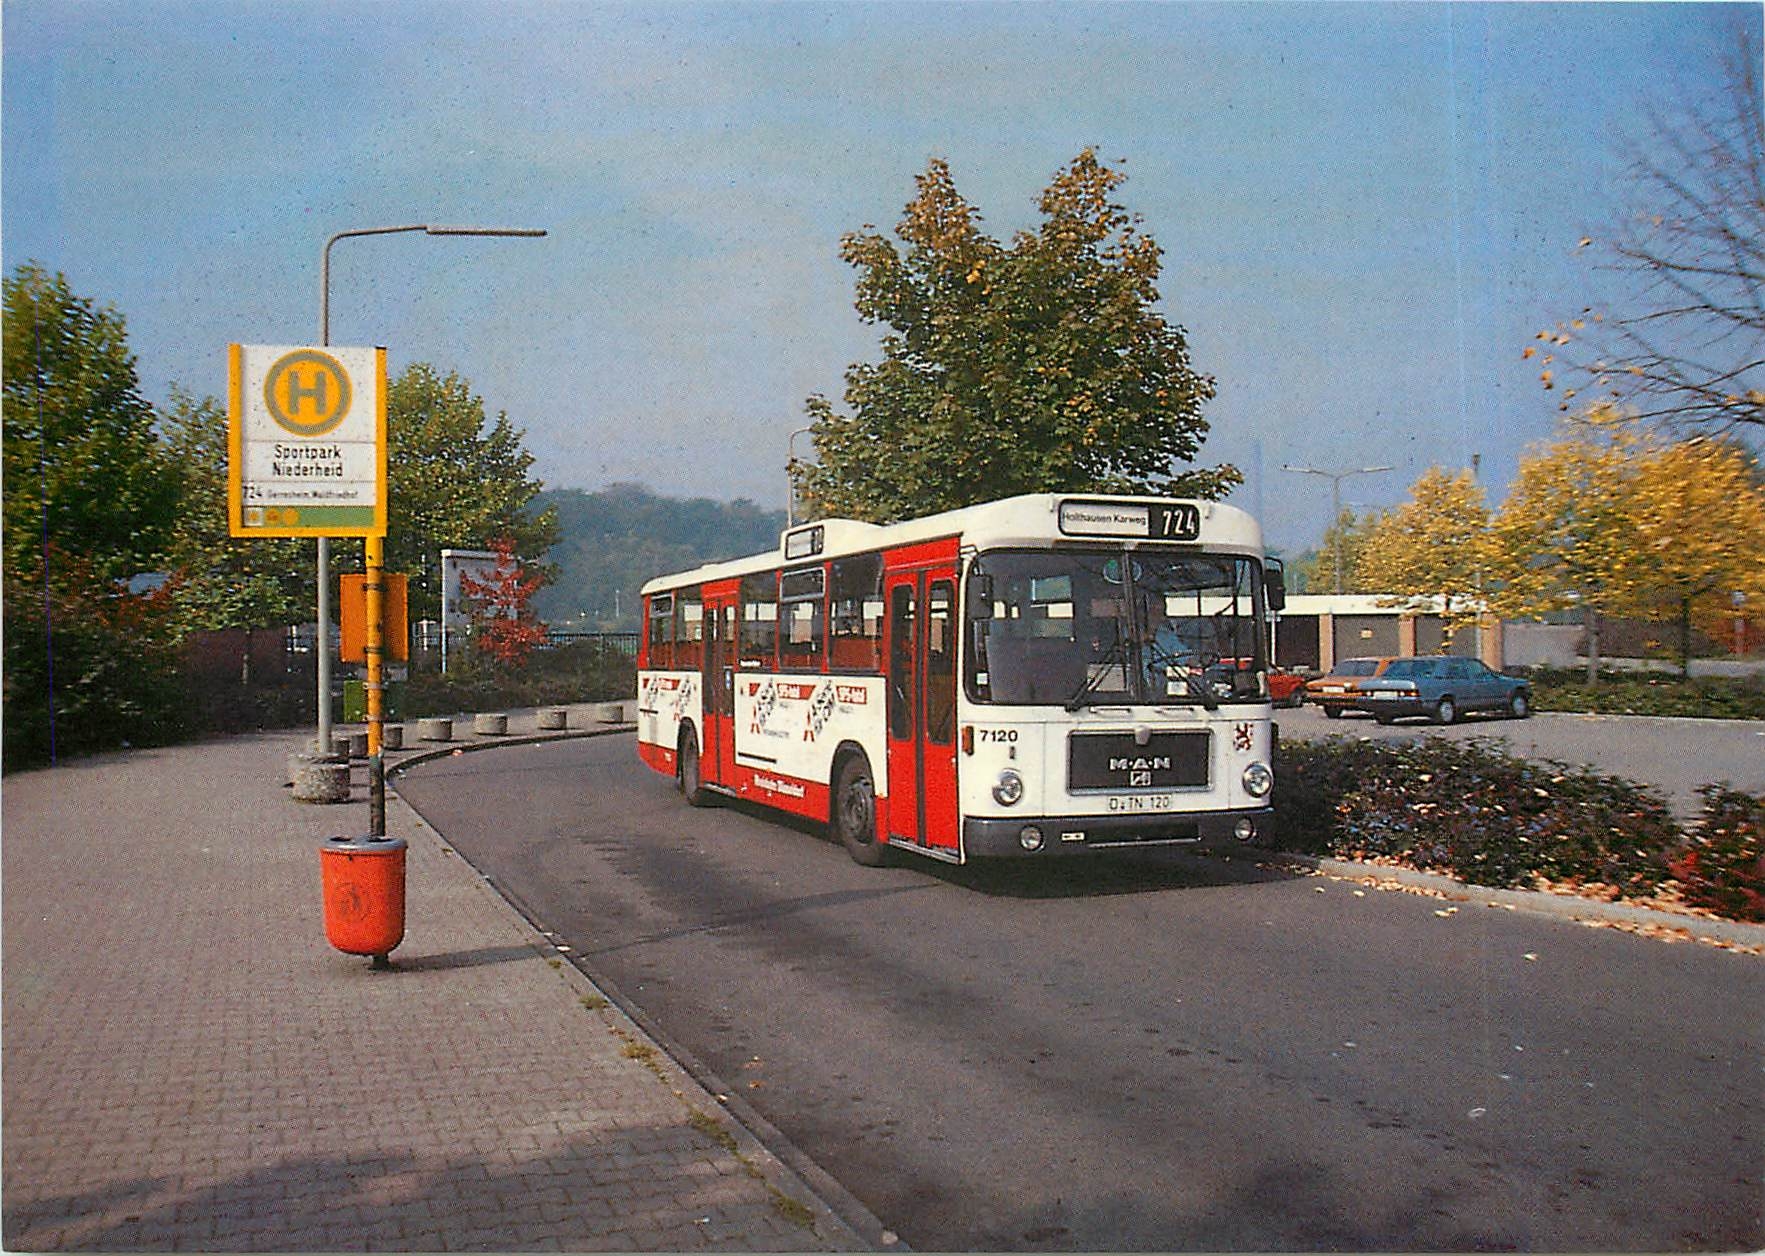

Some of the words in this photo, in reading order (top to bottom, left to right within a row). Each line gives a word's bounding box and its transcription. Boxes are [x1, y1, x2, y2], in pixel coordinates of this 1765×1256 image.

[288, 371, 326, 415] H
[274, 444, 342, 460] Sportpark
[273, 461, 343, 477] Niederheid
[242, 484, 262, 498] 724
[1163, 510, 1195, 535] 724
[979, 730, 1018, 742] 7120
